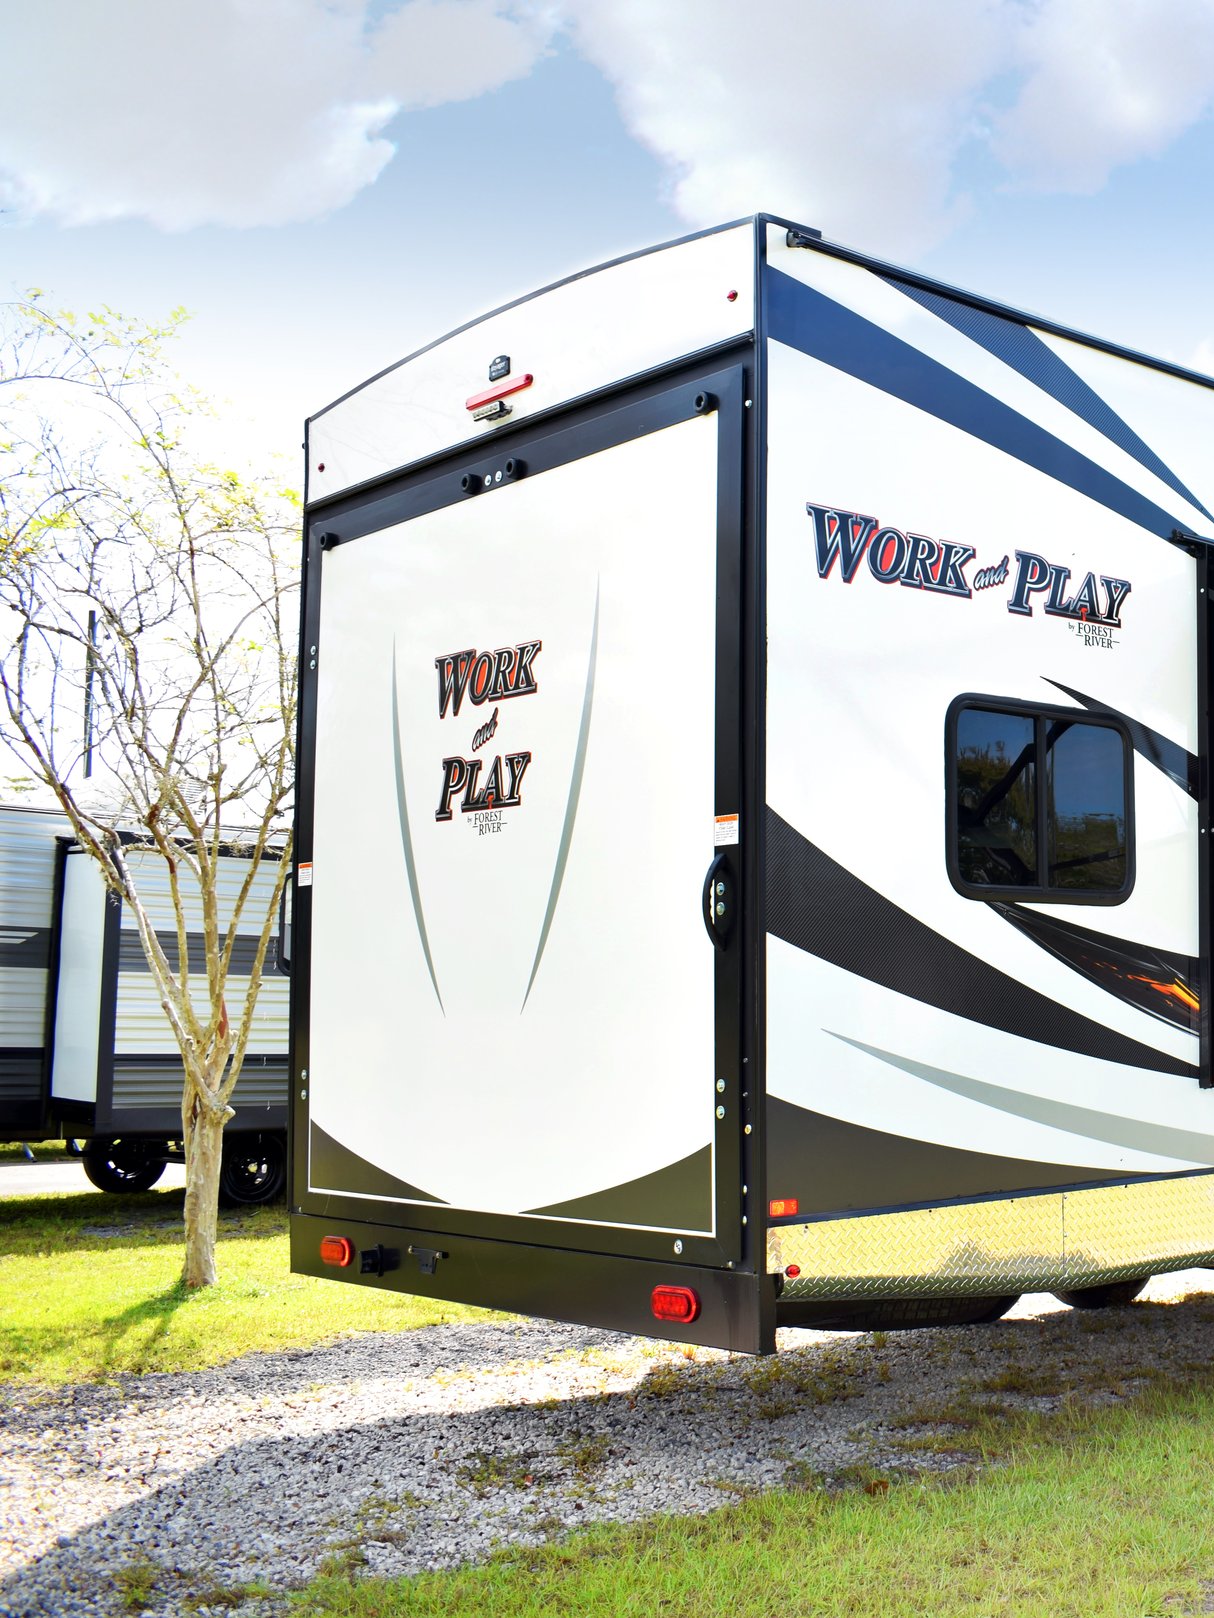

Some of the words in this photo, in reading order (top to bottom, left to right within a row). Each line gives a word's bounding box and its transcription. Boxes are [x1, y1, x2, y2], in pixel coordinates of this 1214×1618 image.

[806, 502, 976, 599] WORK
[973, 555, 1009, 591] and
[1007, 549, 1131, 628] PLAY
[1068, 622, 1075, 632] by
[1077, 622, 1114, 638] FOREST
[1084, 634, 1113, 649] RIVER
[435, 640, 542, 719] WORK
[472, 706, 498, 752] and
[435, 751, 531, 822] PLAY
[474, 810, 503, 825] FOREST
[479, 822, 502, 836] RIVER
